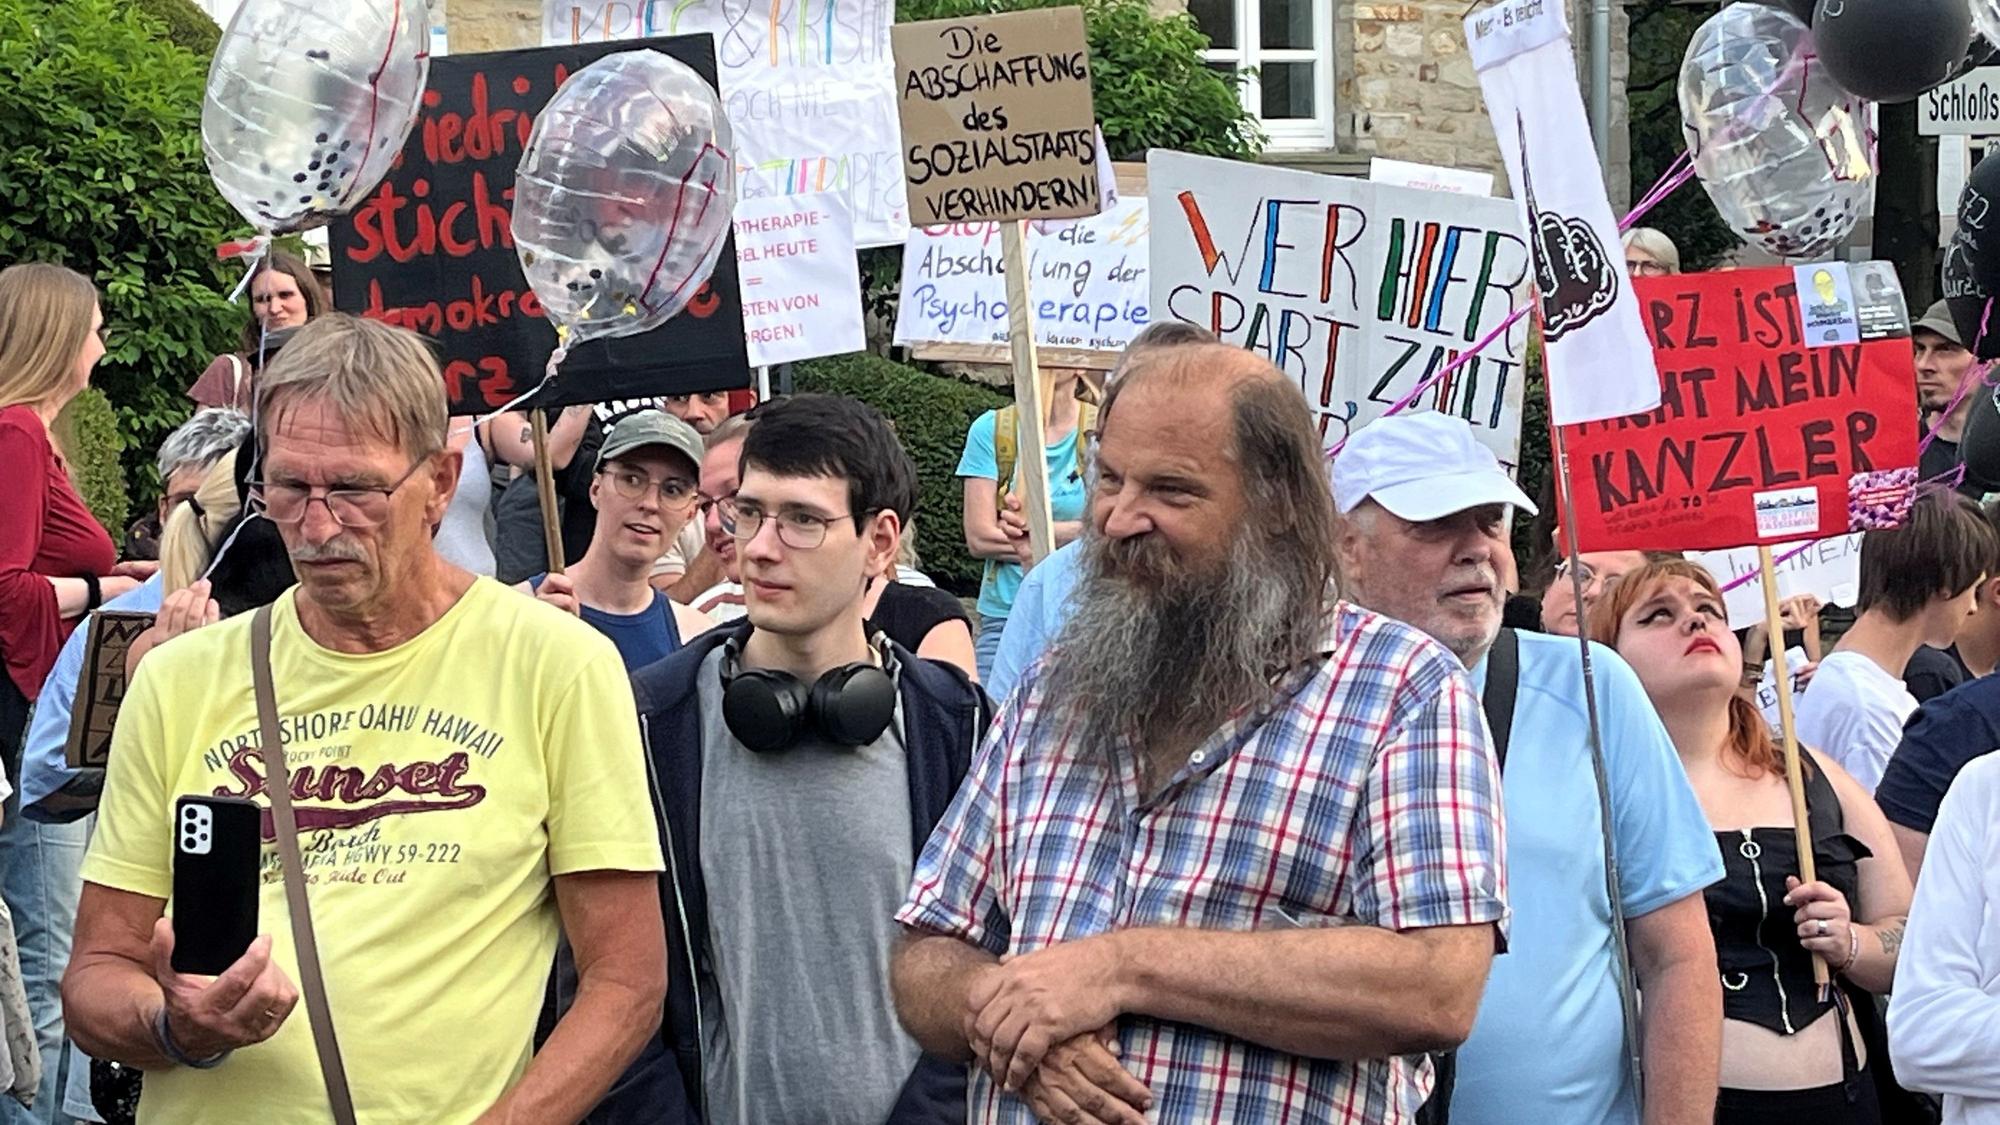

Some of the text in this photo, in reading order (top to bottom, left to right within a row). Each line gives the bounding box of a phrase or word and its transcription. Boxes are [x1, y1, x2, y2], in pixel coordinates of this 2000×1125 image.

[721, 0, 764, 68] &
[939, 25, 1002, 59] Die
[904, 52, 1087, 100] ABSCHAFFUNG
[724, 86, 781, 121] OCH
[962, 102, 1009, 131] des
[908, 129, 1096, 185] SOZIALSTAATS
[347, 170, 515, 263] stich
[925, 174, 1100, 221] VERHINDERN!
[764, 238, 818, 259] HEUTE
[1059, 224, 1097, 245] die
[1107, 255, 1148, 283] der
[1177, 190, 1530, 358] WER HIER
[784, 293, 820, 311] VON
[912, 284, 1151, 334] Psychoerapie
[1650, 293, 1717, 349] RZ
[1367, 335, 1521, 429] ZAHLT
[1592, 411, 1878, 513] KANZLER
[203, 703, 504, 773] NORT SHORE OAHU HAWAII
[396, 842, 461, 864] 59-222
